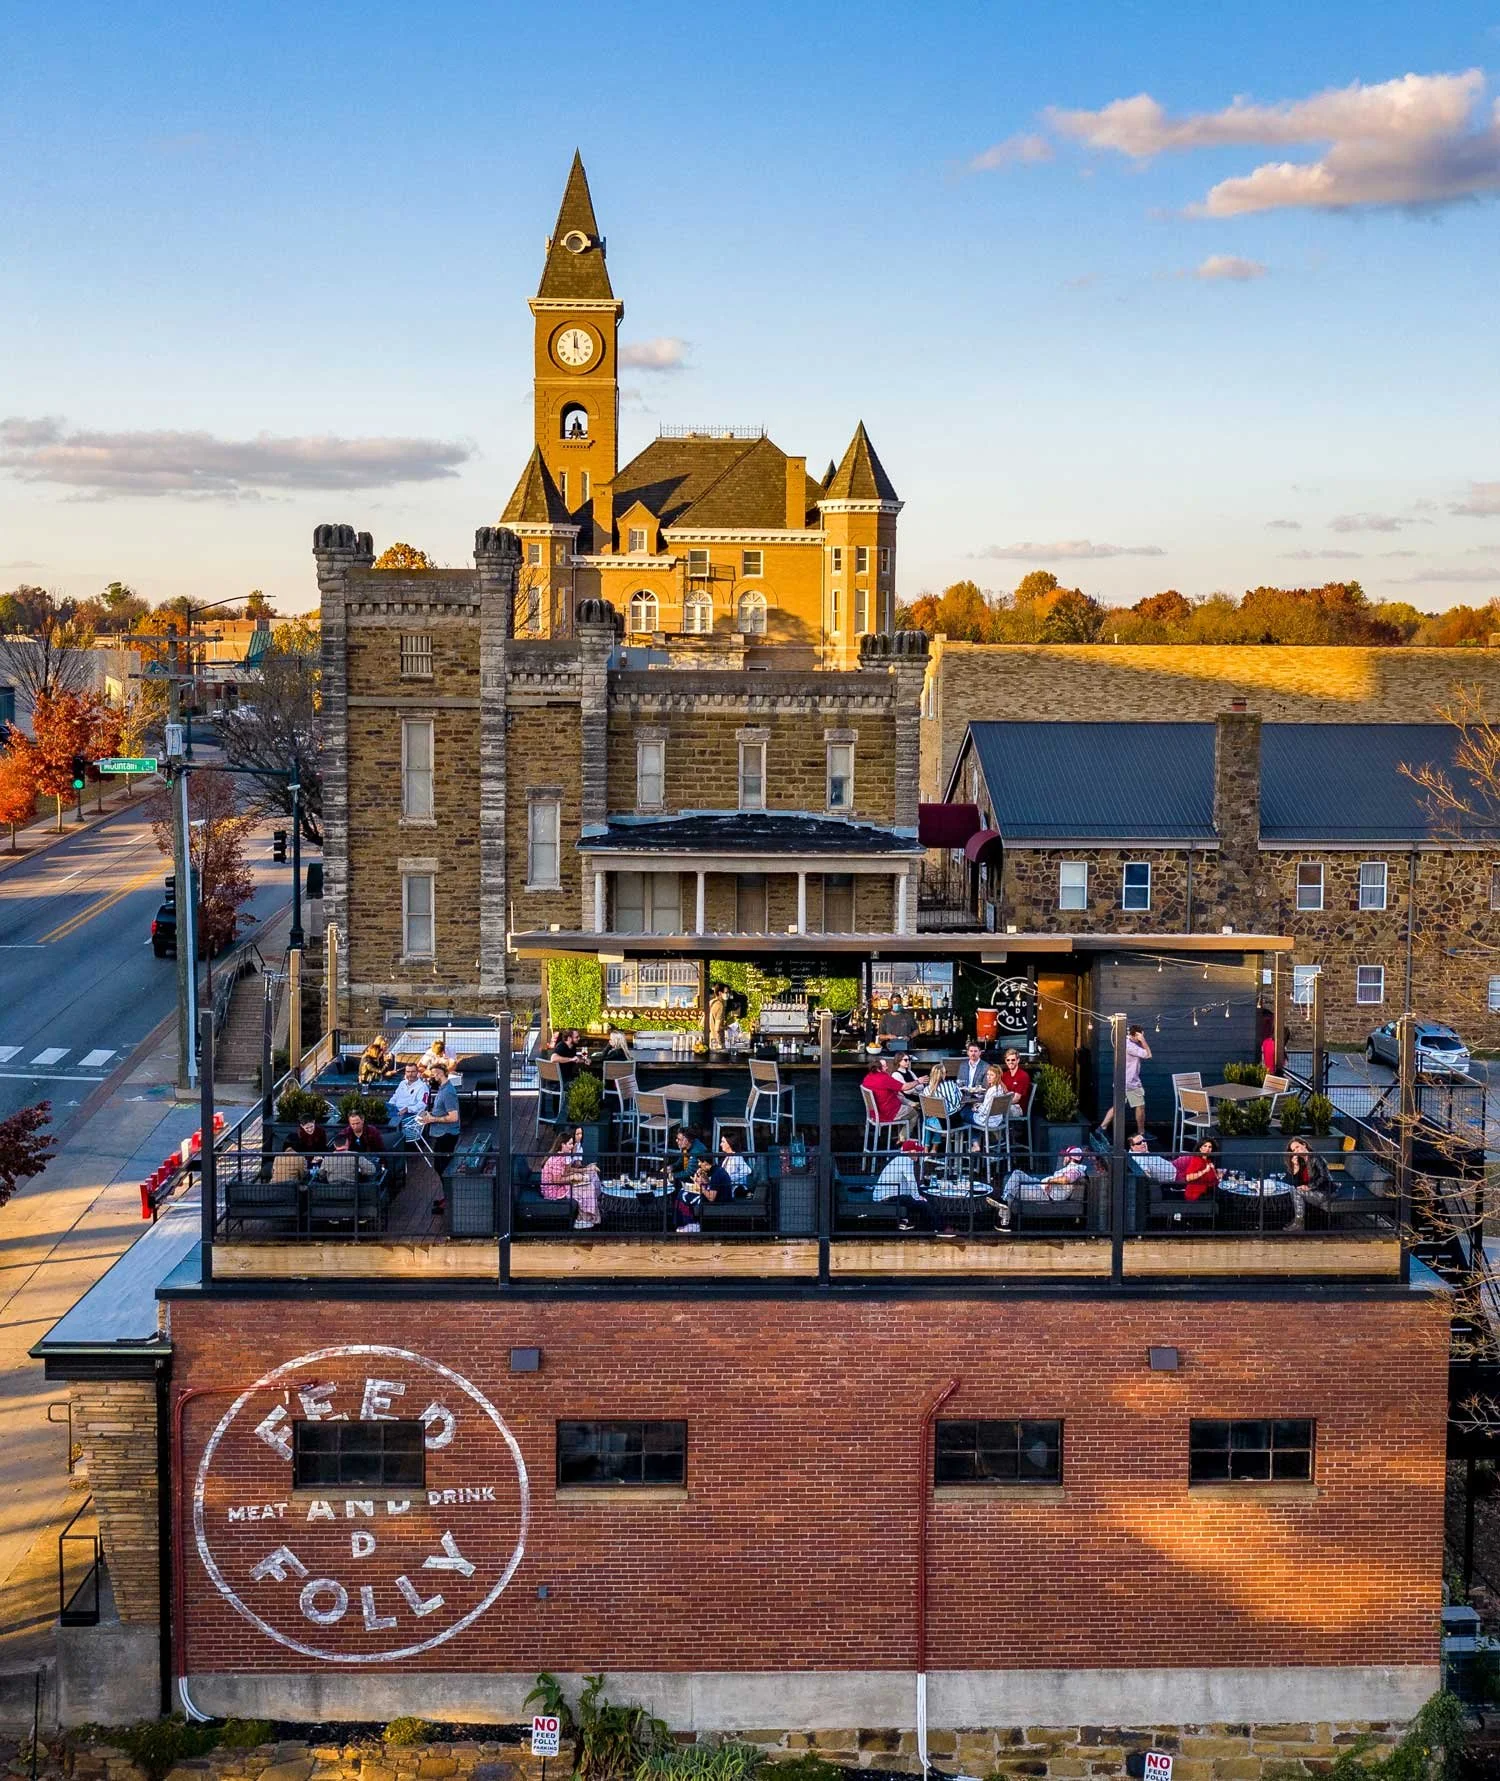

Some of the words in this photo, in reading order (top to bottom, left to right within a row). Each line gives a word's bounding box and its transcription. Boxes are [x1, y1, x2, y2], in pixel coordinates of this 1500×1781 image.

[1002, 982, 1036, 996] FEE
[254, 1378, 456, 1461] FEED
[227, 1502, 288, 1523] MEAT
[427, 1486, 497, 1506] DRINK
[351, 1530, 377, 1558] D
[250, 1530, 477, 1632] FOLLY
[535, 1718, 557, 1731] NO
[1147, 1755, 1171, 1769] NO
[1148, 1768, 1168, 1776] FEED
